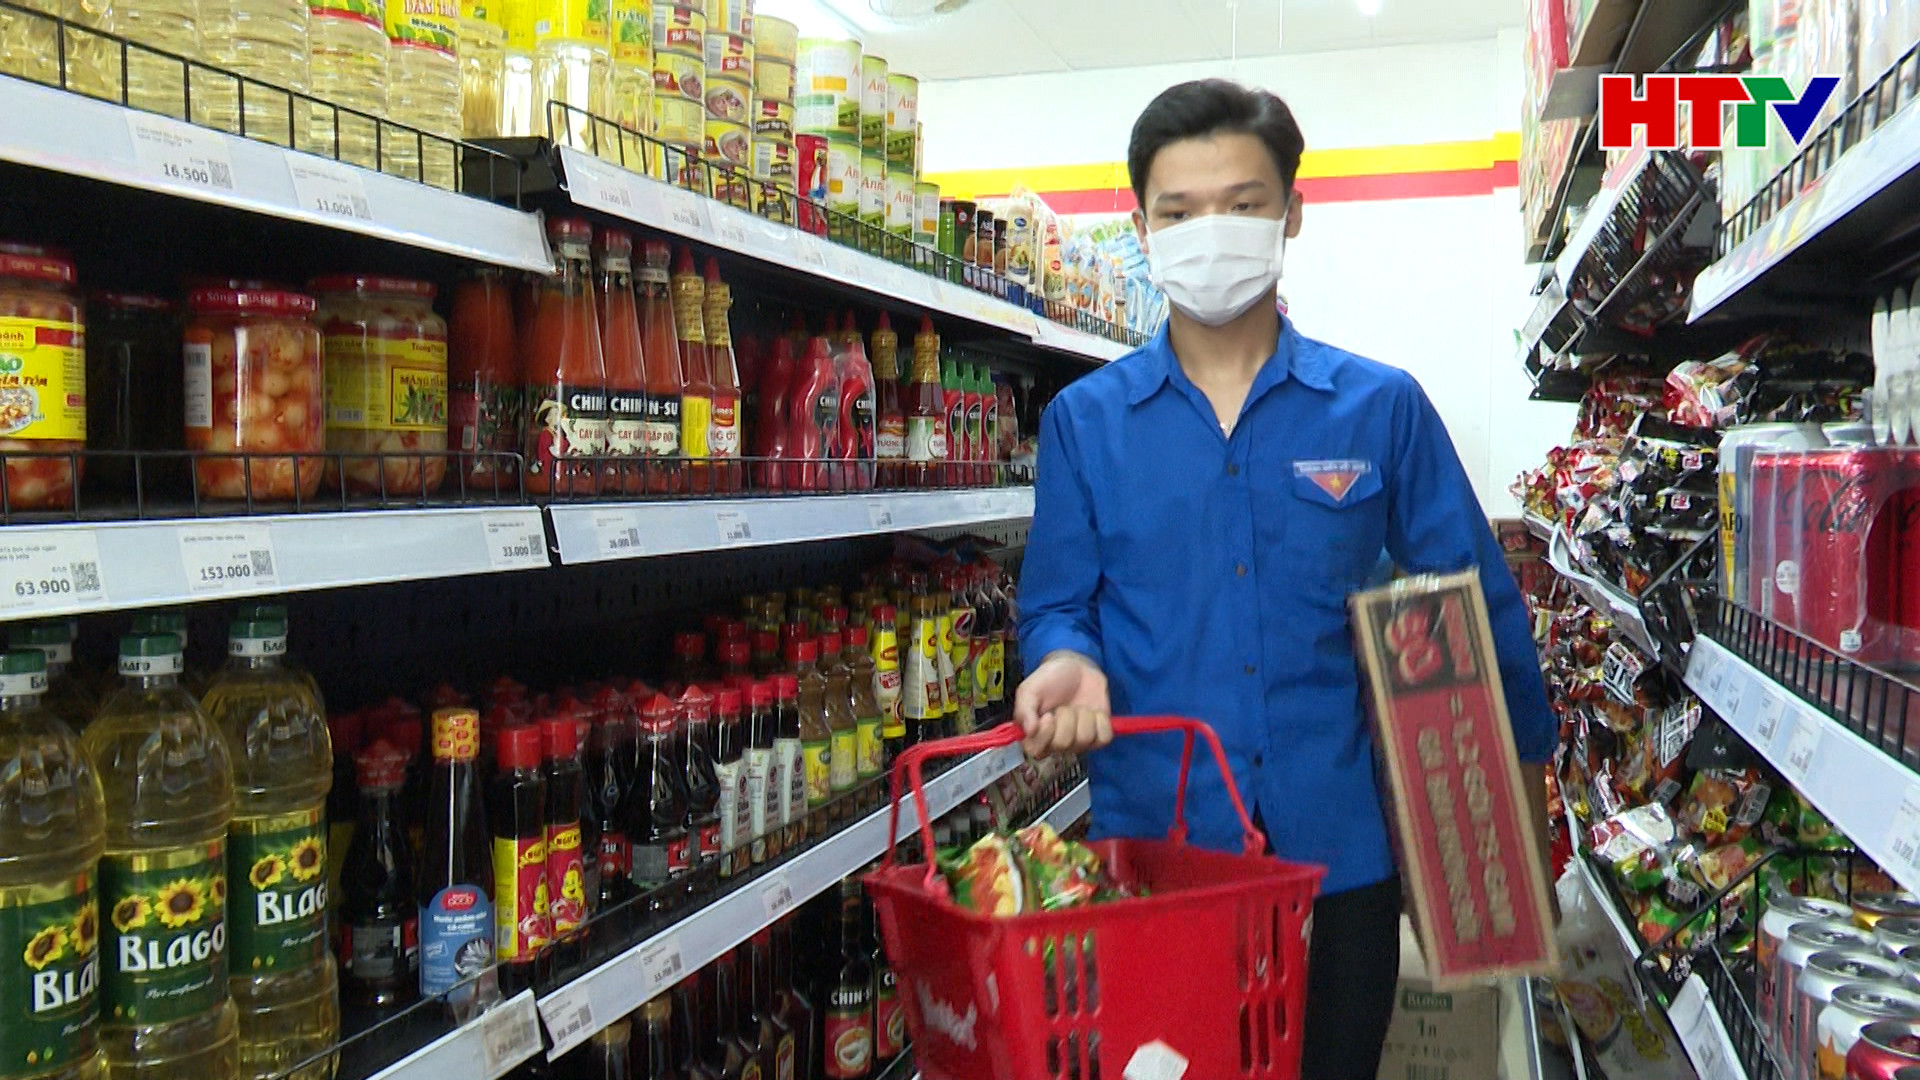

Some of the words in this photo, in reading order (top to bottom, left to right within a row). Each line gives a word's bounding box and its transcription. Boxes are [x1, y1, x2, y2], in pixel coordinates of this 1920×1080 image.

[164, 163, 208, 184] 16.500
[200, 563, 251, 581] 153.000
[15, 579, 71, 597] 63.900
[118, 921, 226, 974] BLAGO
